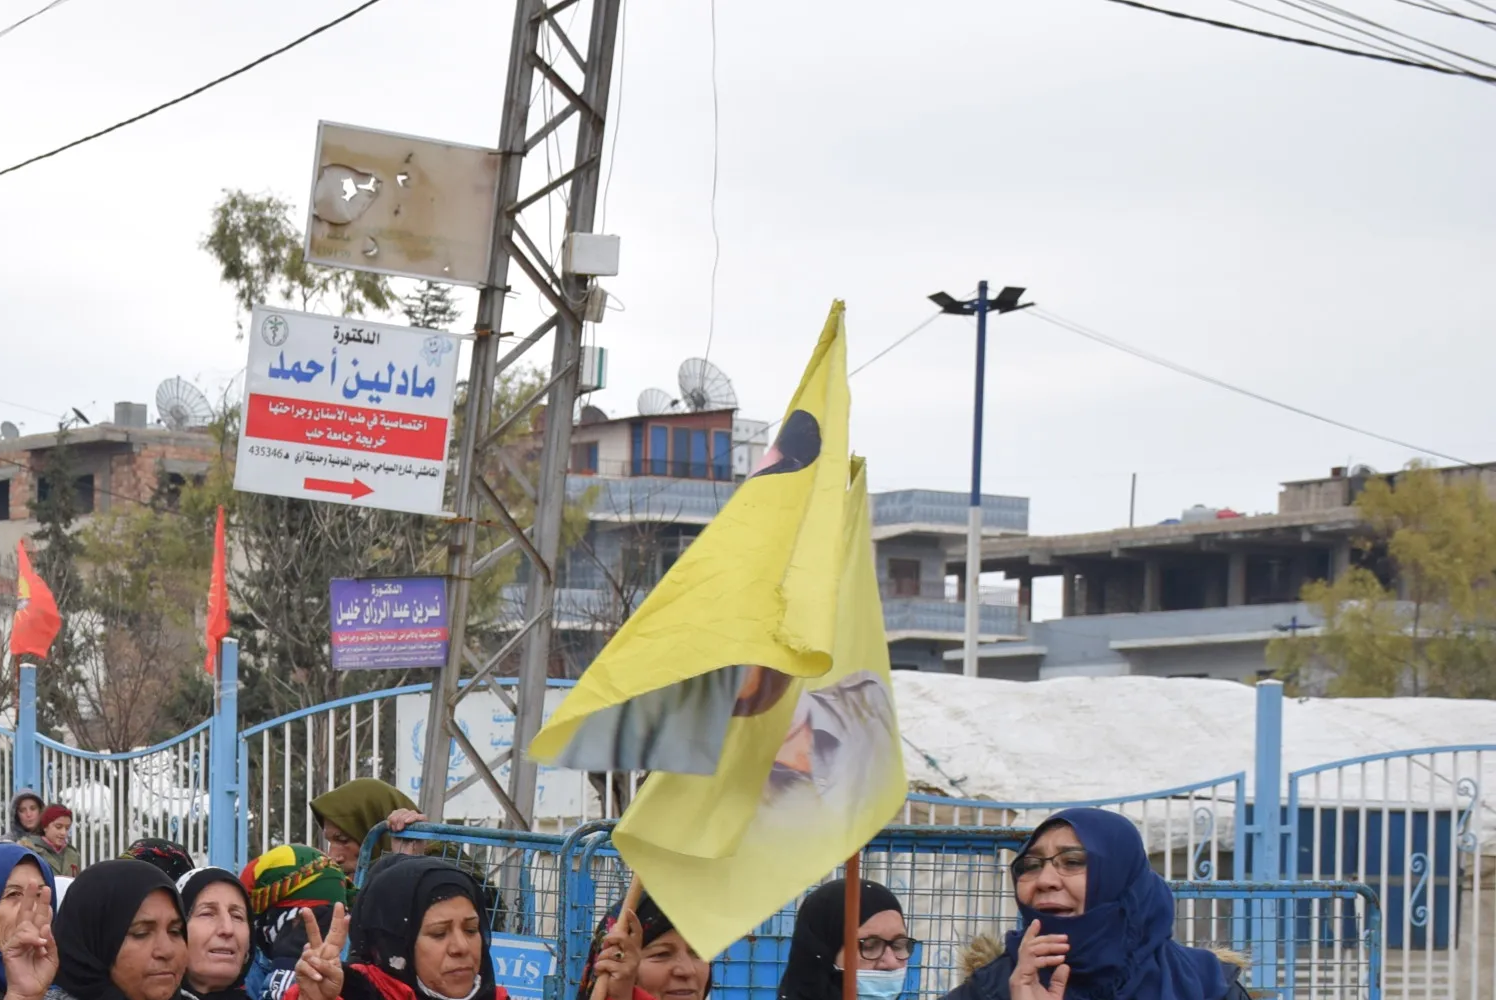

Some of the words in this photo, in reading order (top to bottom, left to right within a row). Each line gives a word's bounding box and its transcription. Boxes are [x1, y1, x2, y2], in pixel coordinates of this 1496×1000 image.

[333, 325, 380, 345] الدكتورة
[268, 346, 337, 386] أحمد
[342, 358, 436, 404] مادلين
[268, 400, 313, 420] وجراحتها
[348, 411, 366, 426] طب
[366, 412, 379, 431] في
[379, 413, 428, 431] اختصاصية
[305, 427, 324, 440] حلب
[326, 427, 353, 446] جامعة
[355, 431, 387, 449] خريجة
[248, 445, 283, 459] 435346
[371, 583, 403, 597] الدكتورة
[336, 598, 361, 626] خليل
[363, 598, 391, 625] الرزاق
[392, 600, 410, 624] عبد
[412, 595, 441, 624] نسرين
